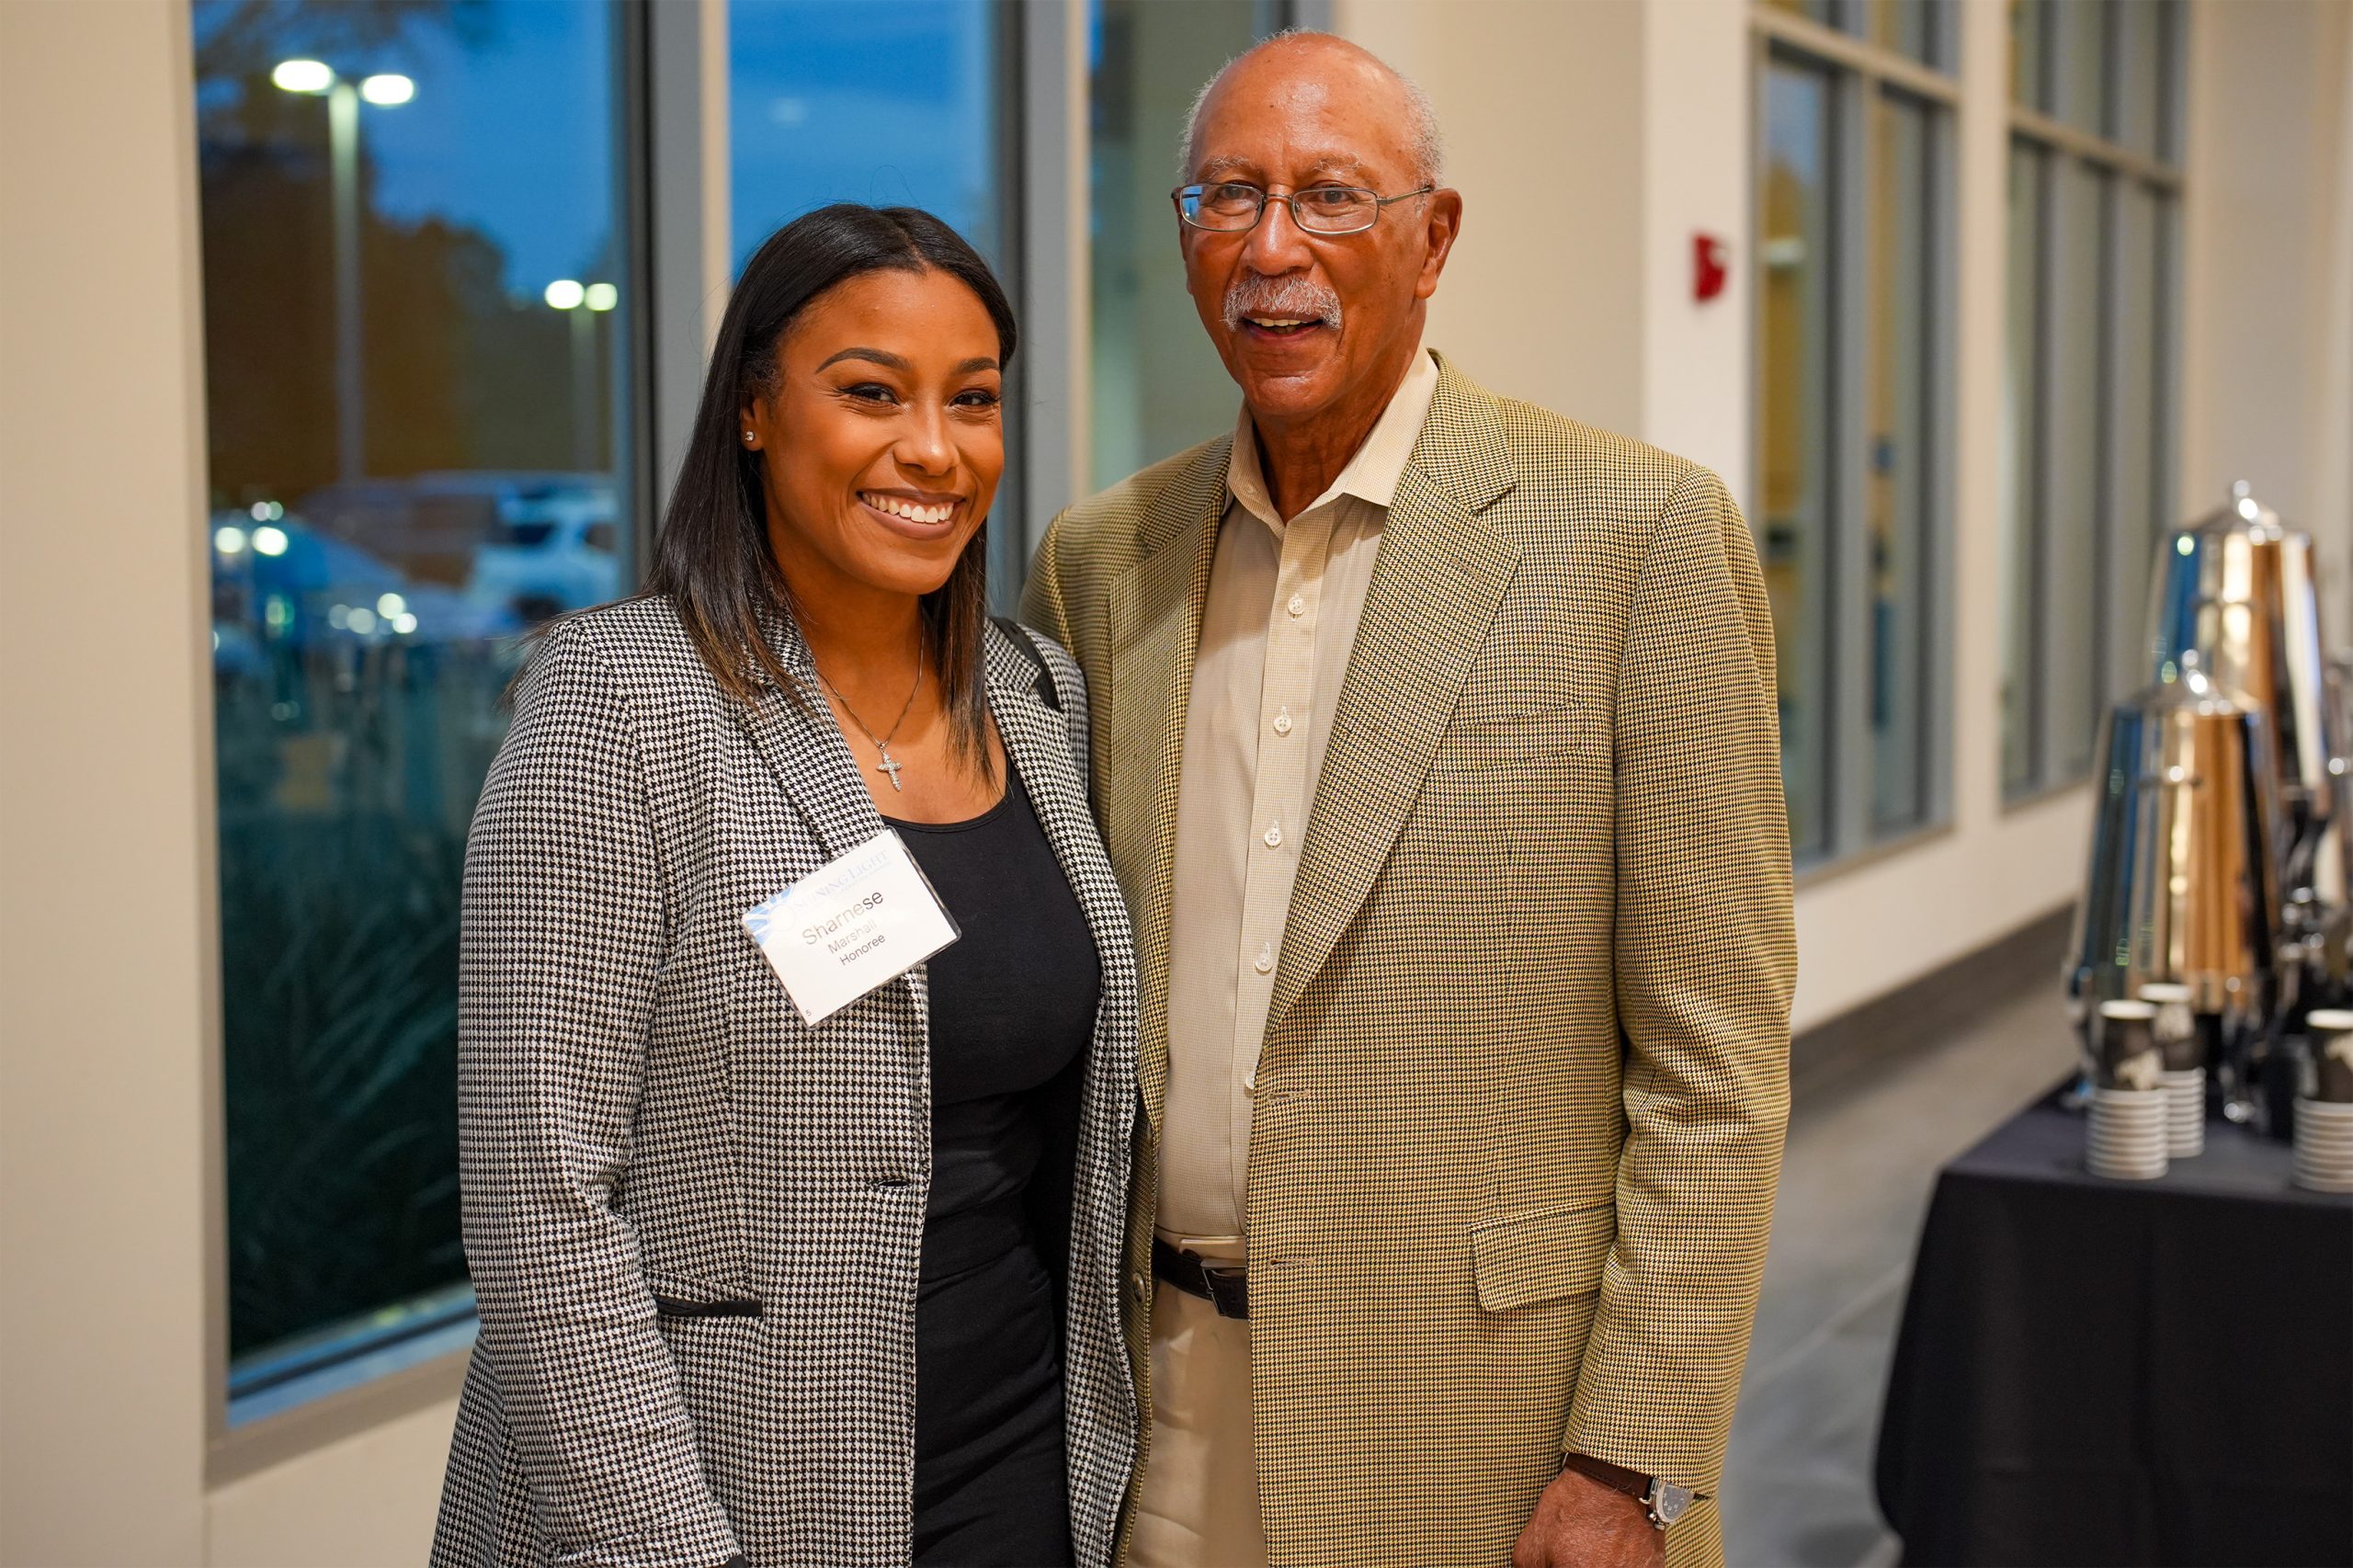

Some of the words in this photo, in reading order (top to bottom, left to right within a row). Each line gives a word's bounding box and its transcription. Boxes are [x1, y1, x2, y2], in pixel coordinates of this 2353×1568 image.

[848, 850, 890, 880] LIGHT
[801, 891, 884, 945] Sharnese
[828, 919, 878, 954] Marshall
[840, 934, 886, 966] Honoree
[805, 1009, 813, 1017] 5
